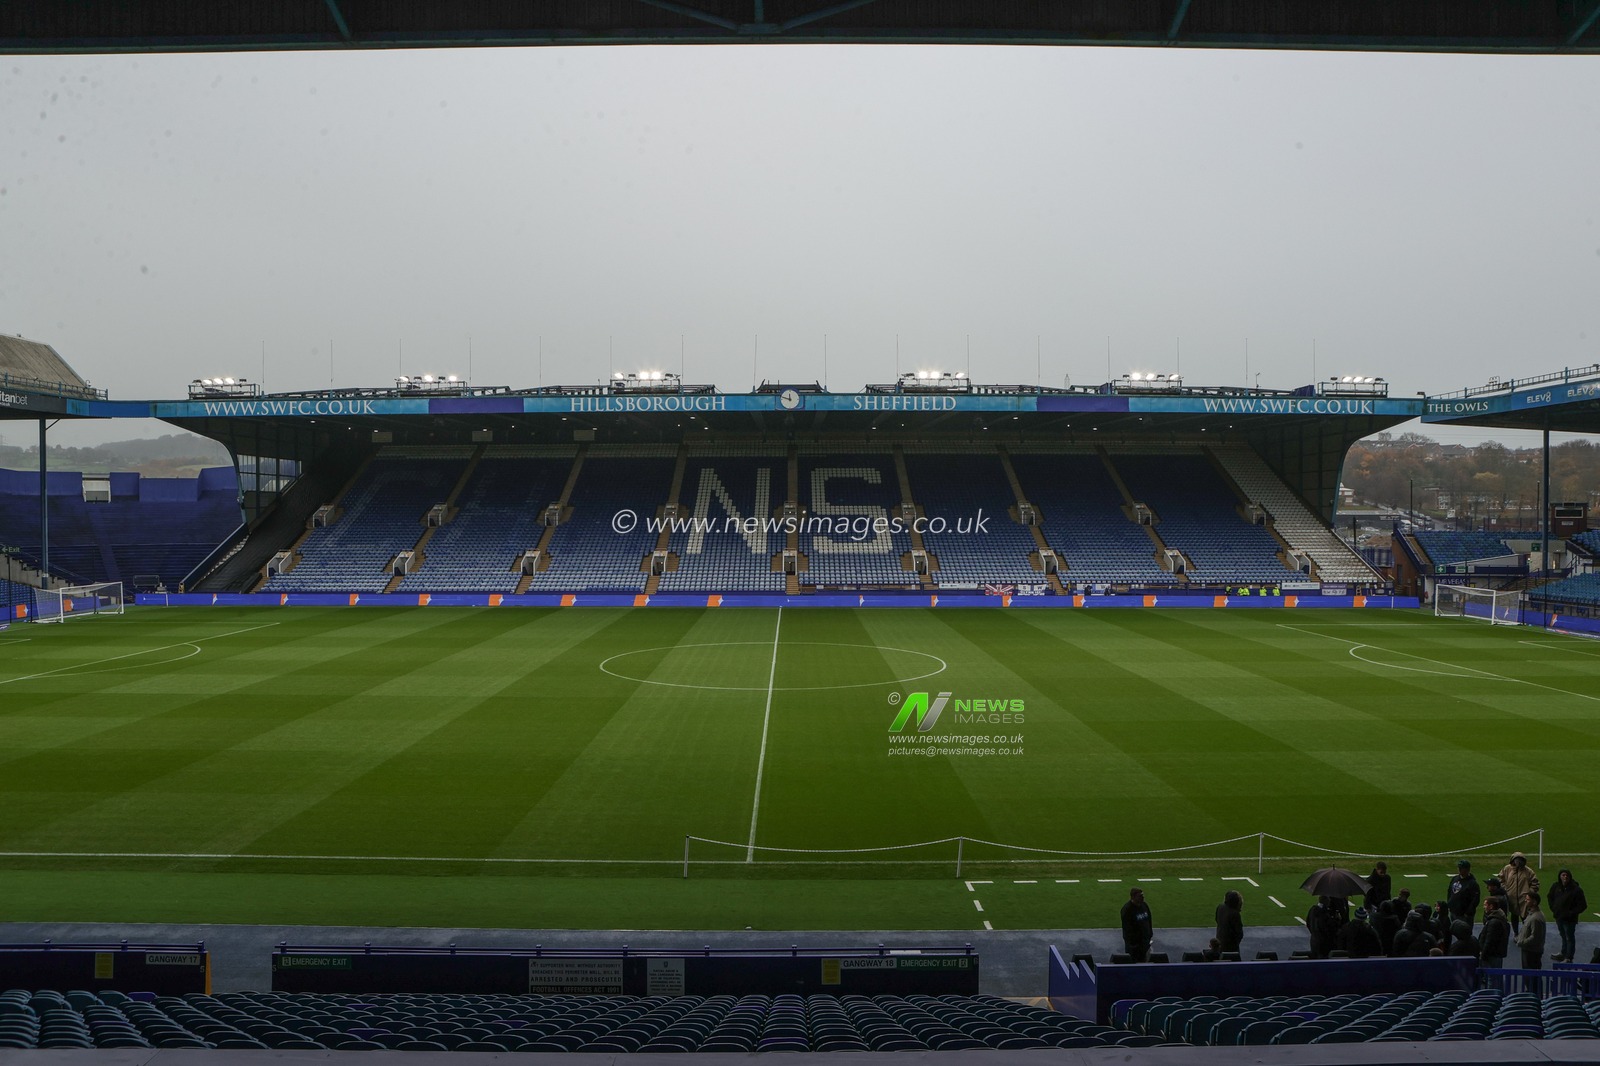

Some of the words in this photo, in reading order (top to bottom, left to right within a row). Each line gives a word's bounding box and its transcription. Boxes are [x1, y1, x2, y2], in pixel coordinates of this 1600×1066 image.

[204, 400, 376, 416] WWW.SWFC.CO.UK
[570, 396, 726, 412] HILLSBOROUGH
[853, 396, 957, 411] SHEFFIELD
[1202, 398, 1374, 414] WWW.SWFC.CO.UK
[1427, 403, 1452, 413] THE
[1454, 401, 1489, 413] OWLS
[148, 955, 187, 964] GANGWAY
[189, 955, 198, 963] 17
[291, 957, 331, 966] EMERGENCY
[332, 957, 347, 966] EXIT
[843, 959, 883, 968] GANGWAY
[885, 959, 894, 967] 18
[900, 959, 940, 968] EMERGENCY
[942, 959, 957, 967] EXIT
